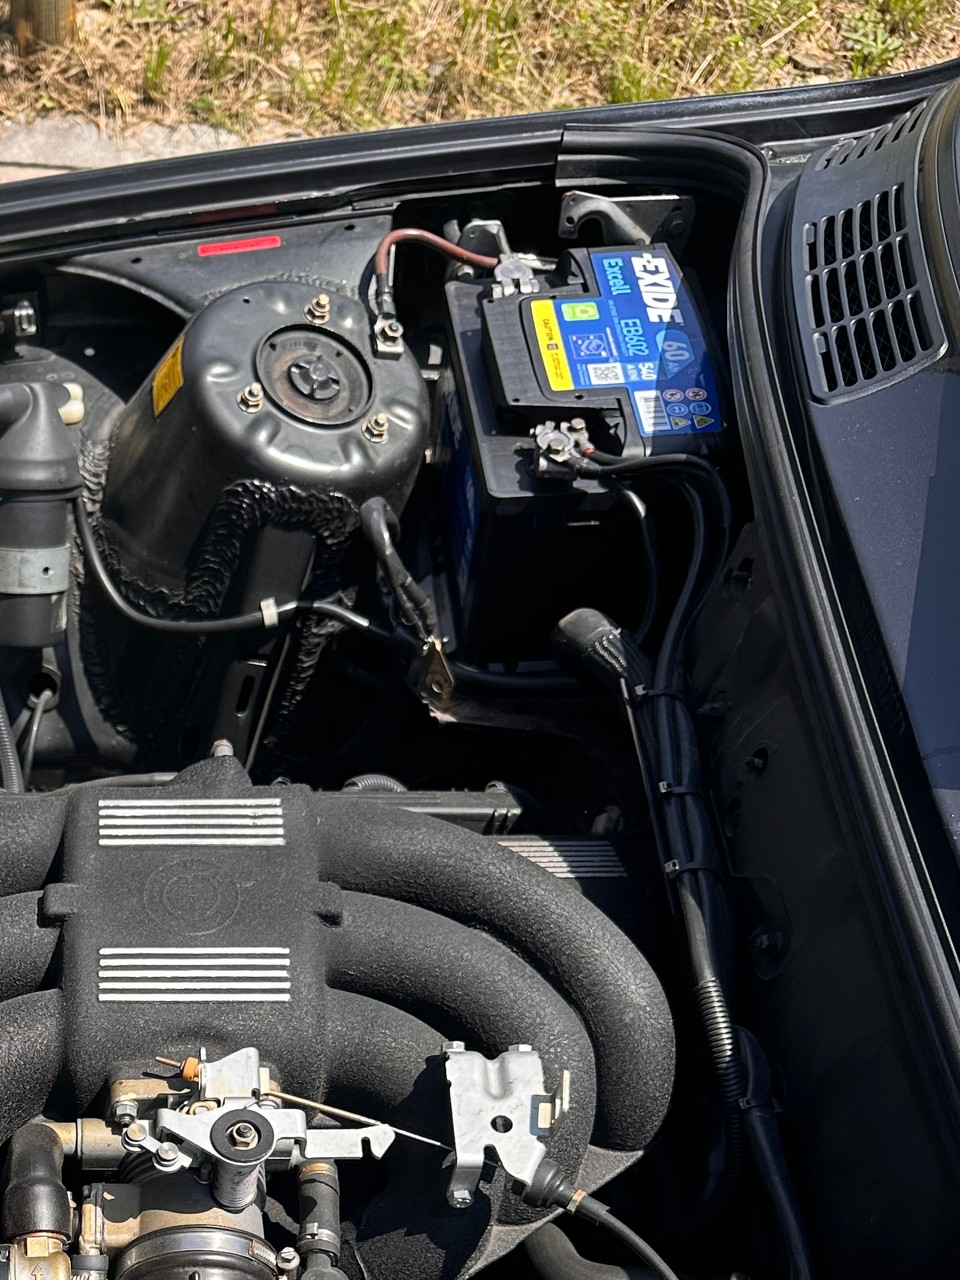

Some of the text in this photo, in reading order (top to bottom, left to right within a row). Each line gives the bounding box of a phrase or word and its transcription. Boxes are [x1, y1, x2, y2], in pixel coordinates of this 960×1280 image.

[602, 257, 632, 296] Excell
[631, 252, 685, 325] EXIDE
[620, 318, 650, 357] EB602
[663, 341, 690, 361] 60
[637, 361, 657, 381] 540
